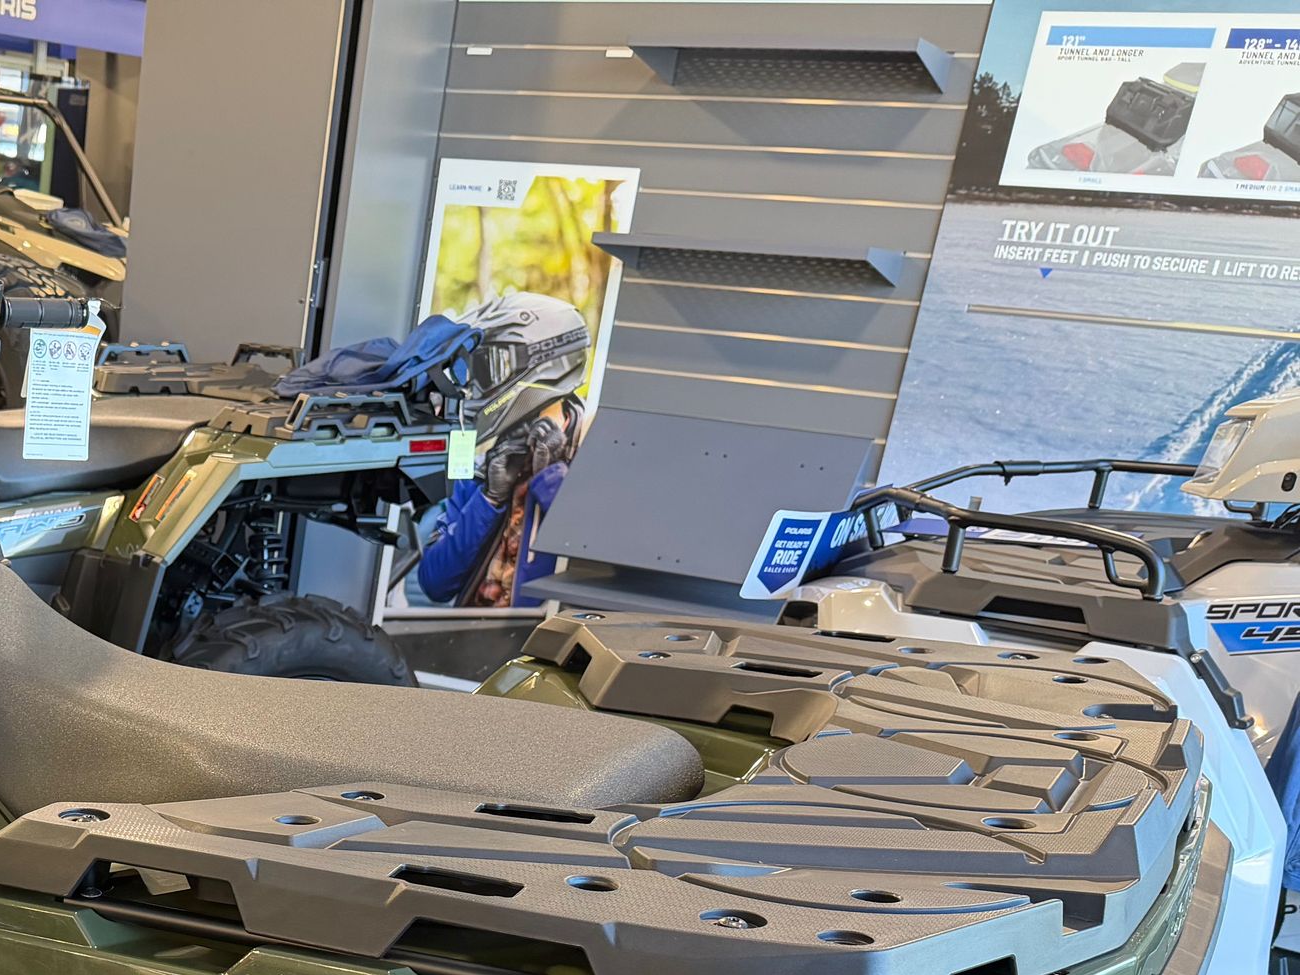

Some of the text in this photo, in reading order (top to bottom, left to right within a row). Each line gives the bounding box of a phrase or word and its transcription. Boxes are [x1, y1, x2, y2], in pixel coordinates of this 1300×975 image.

[1285, 38, 1300, 50] 14
[1060, 48, 1144, 57] TUNNEL AND LONGER
[1241, 51, 1296, 60] TUNNEL AND
[1002, 220, 1120, 247] TRY IT OUT
[994, 245, 1300, 281] INSERT FEET PUSH TO SECURE LIFT TO RE
[784, 527, 813, 535] POLARIS
[771, 549, 802, 566] RIDE
